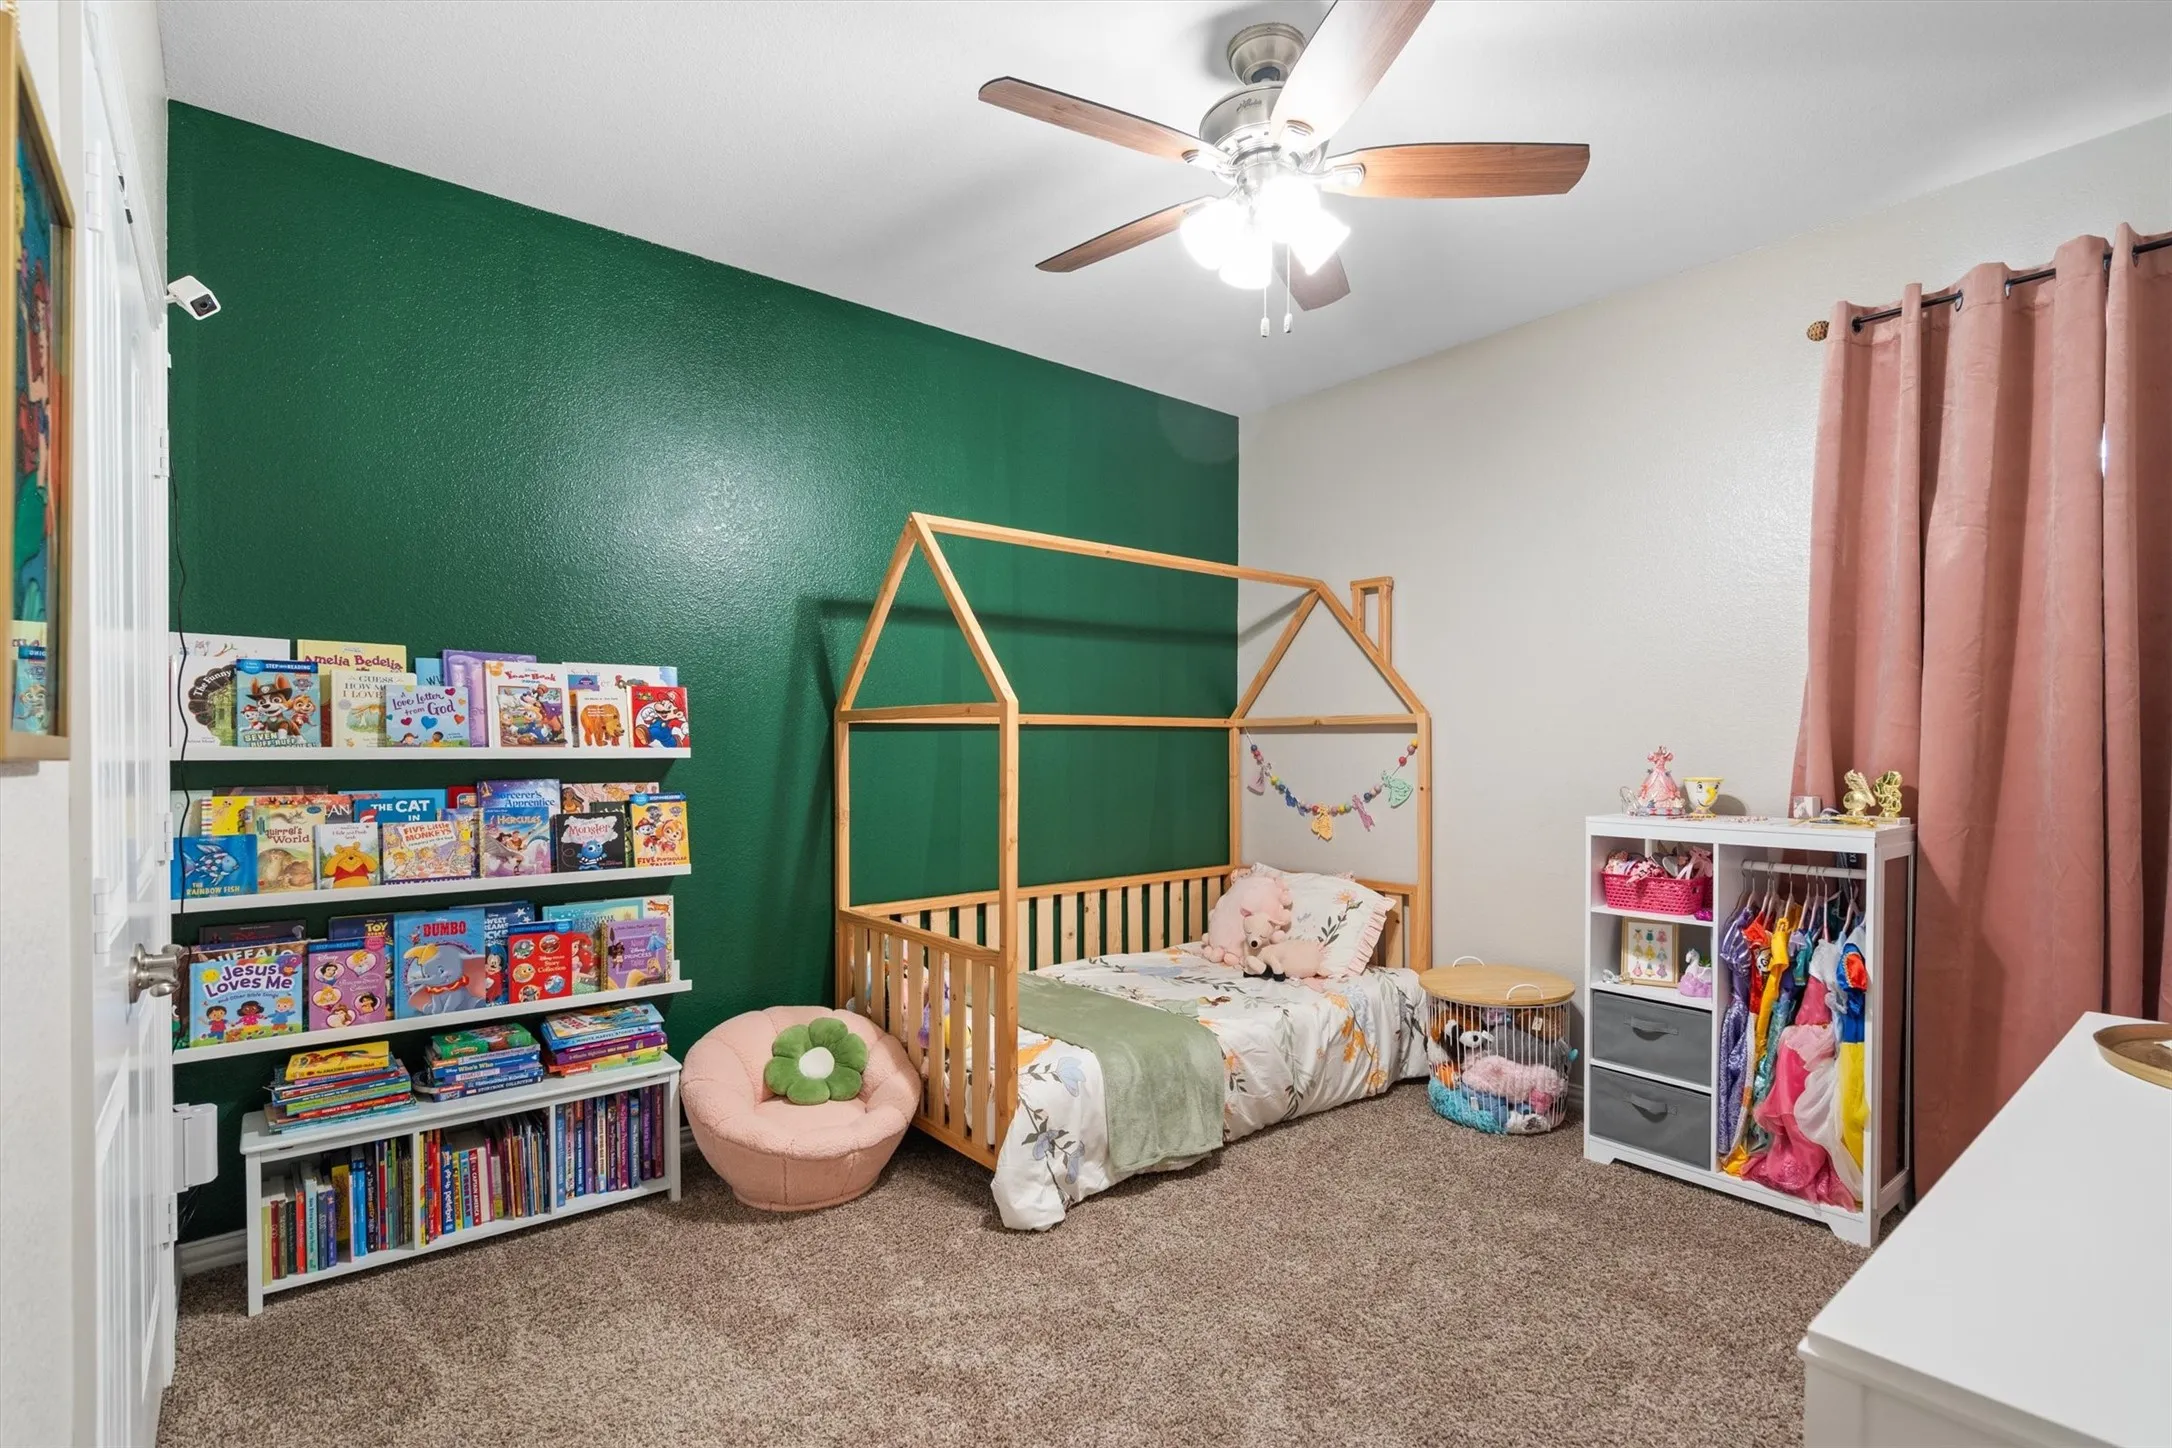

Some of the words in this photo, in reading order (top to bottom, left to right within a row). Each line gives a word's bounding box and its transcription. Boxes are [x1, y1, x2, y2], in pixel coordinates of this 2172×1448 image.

[304, 654, 350, 667] Amelia
[354, 655, 404, 671] Bedelia
[193, 682, 208, 696] The
[203, 670, 232, 685] Funny
[392, 698, 415, 711] Love
[416, 692, 445, 704] Letter
[404, 706, 426, 716] from
[428, 699, 456, 716] God
[244, 733, 277, 742] SEVEN
[370, 803, 392, 812] THE
[396, 800, 430, 812] CAT
[504, 798, 556, 807] Apprentice
[408, 814, 420, 822] IN
[264, 826, 302, 838] quirrel's
[404, 825, 424, 834] FIVE
[405, 829, 452, 841] MONKEYS
[274, 834, 310, 844] World
[637, 857, 656, 865] FIVE
[186, 887, 222, 896] RAINBOW
[224, 886, 240, 894] FISH
[365, 922, 388, 932] TOY
[423, 921, 466, 936] DUMBO
[221, 964, 278, 982] Jesus
[205, 976, 263, 998] Loves
[266, 976, 293, 990] Me
[458, 1064, 478, 1072] Who's
[463, 1175, 471, 1197] IRON
